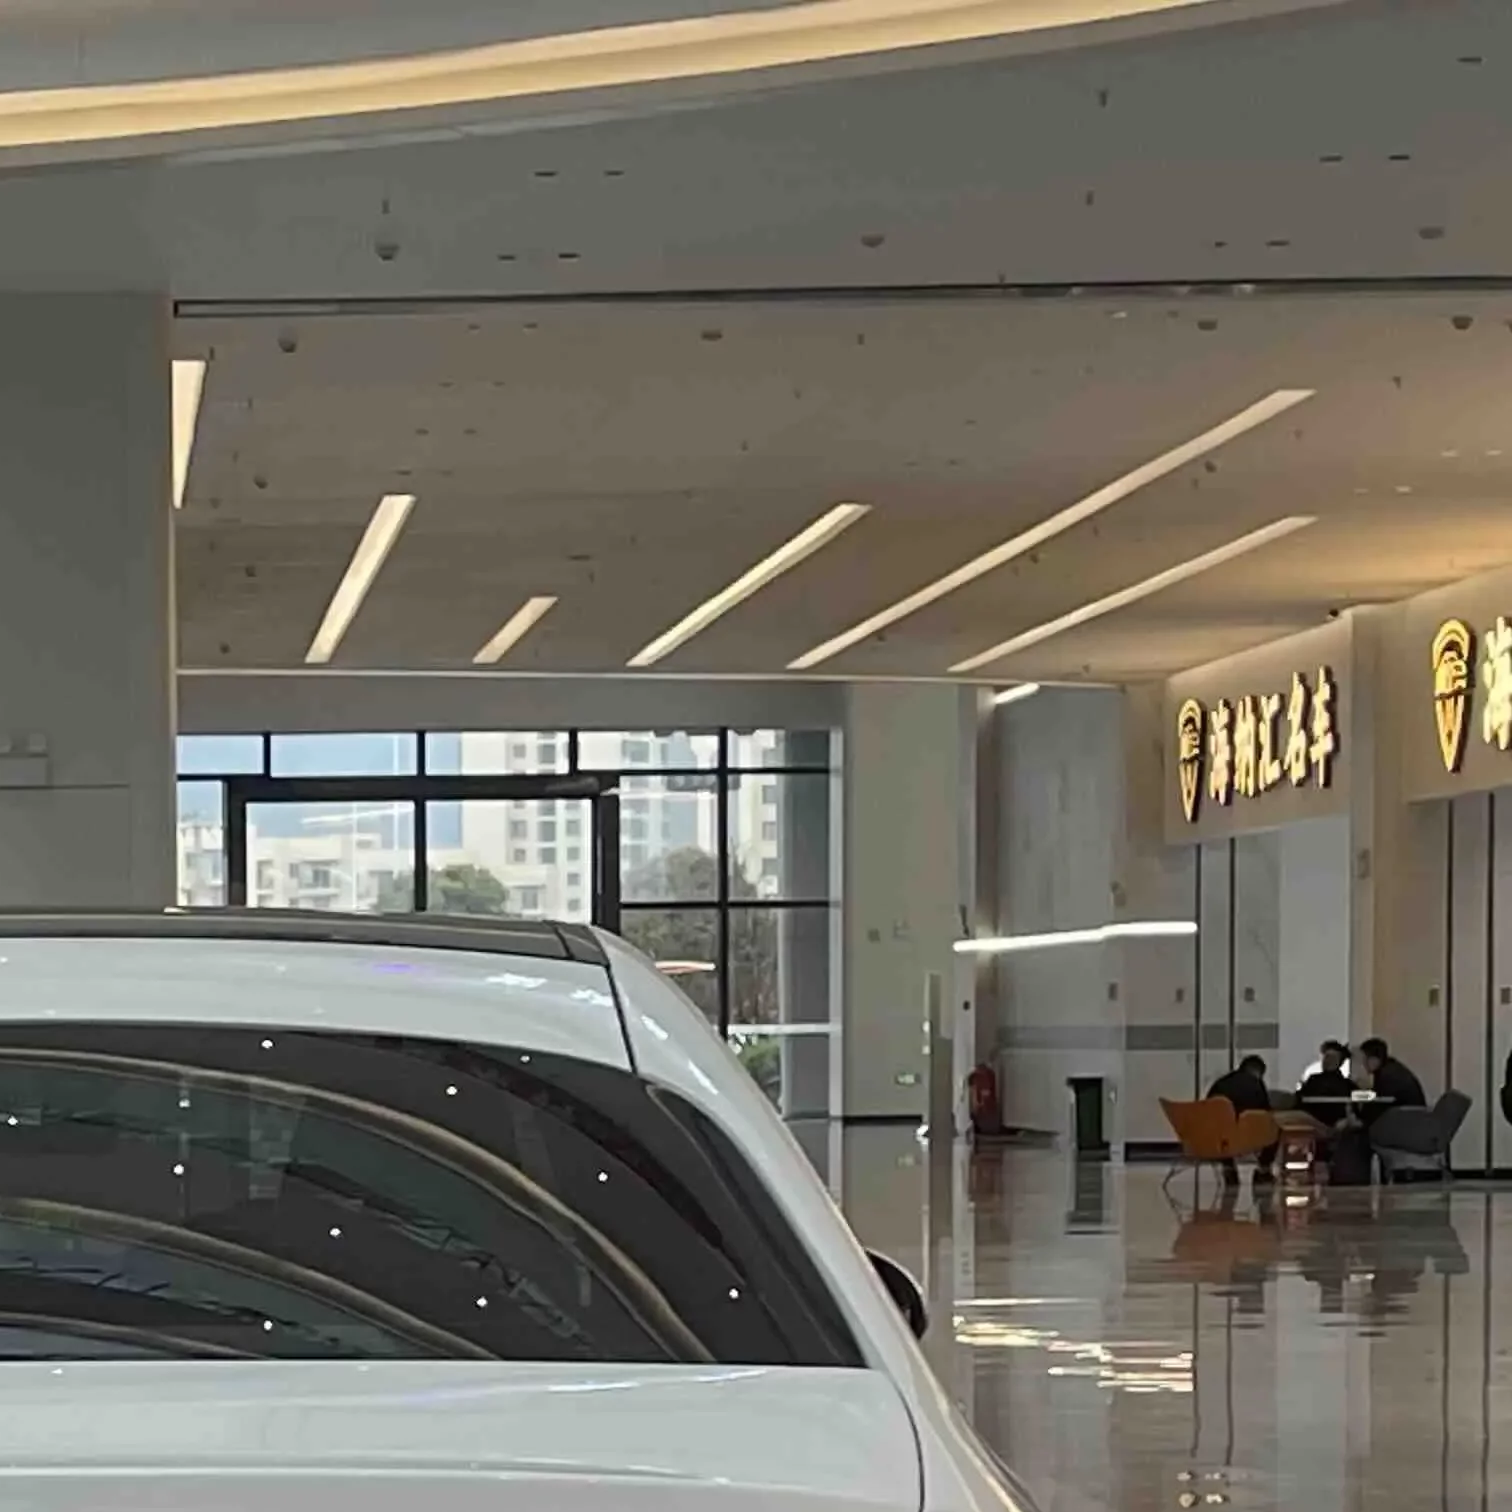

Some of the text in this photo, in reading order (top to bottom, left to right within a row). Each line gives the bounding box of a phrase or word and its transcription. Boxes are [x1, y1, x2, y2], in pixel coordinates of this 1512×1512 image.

[1209, 665, 1335, 806] 海纳汇名车
